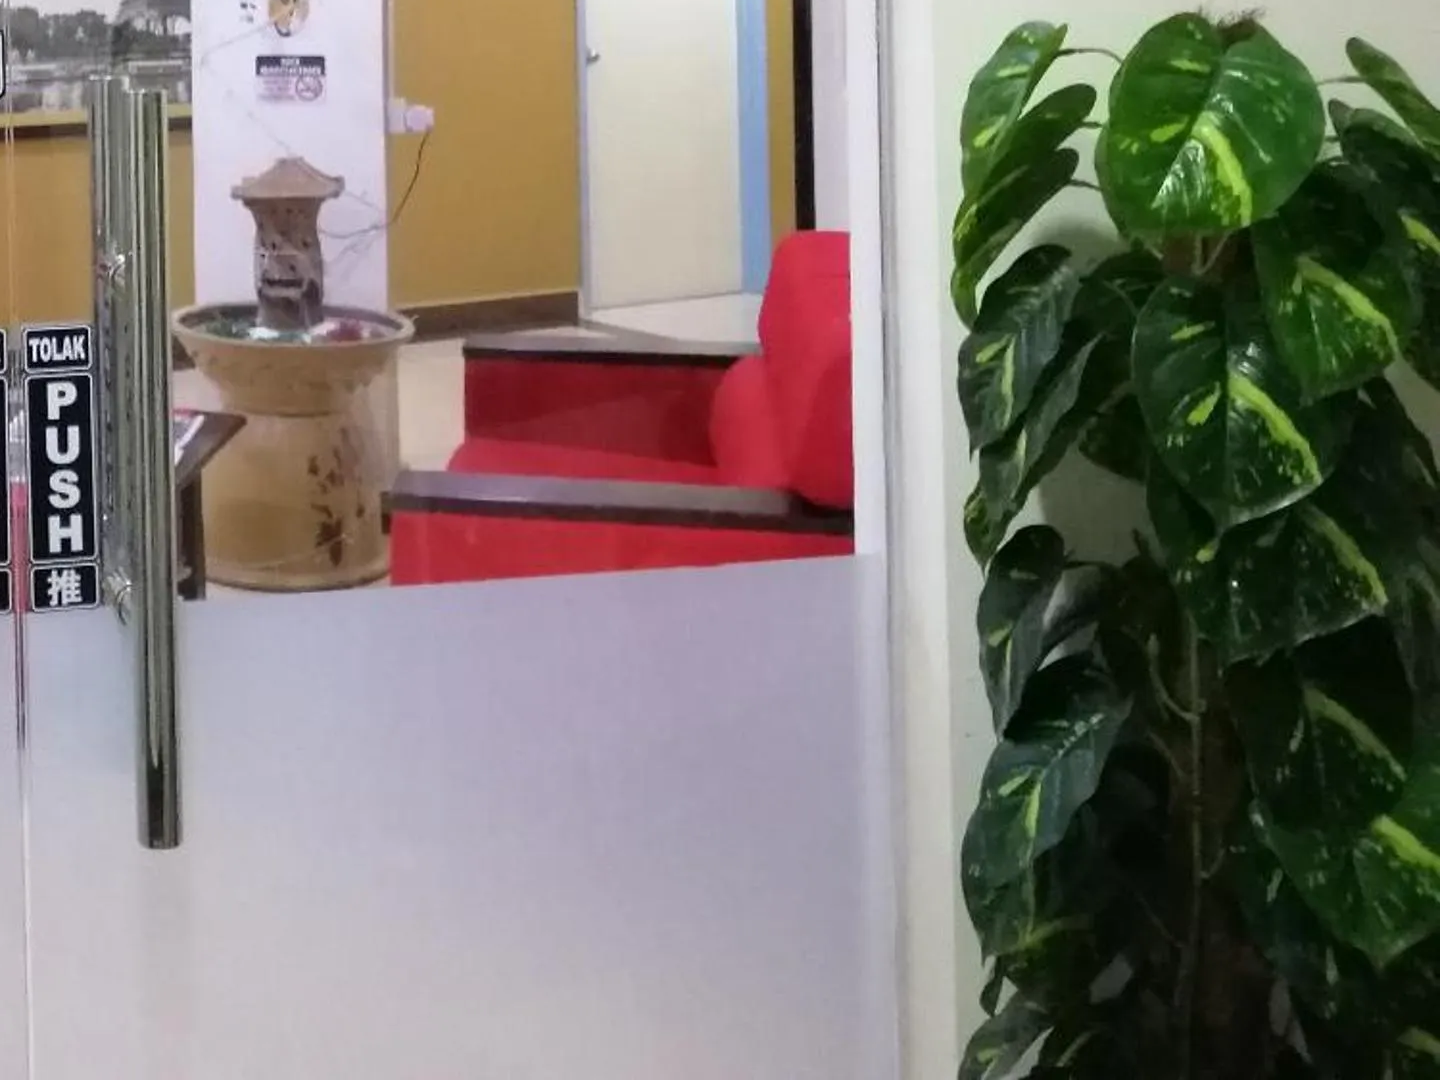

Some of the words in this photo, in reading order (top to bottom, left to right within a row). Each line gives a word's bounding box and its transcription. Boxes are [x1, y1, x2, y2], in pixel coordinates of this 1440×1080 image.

[28, 334, 86, 363] TOLAK
[45, 381, 84, 554] PUSH
[47, 569, 83, 606] 推
